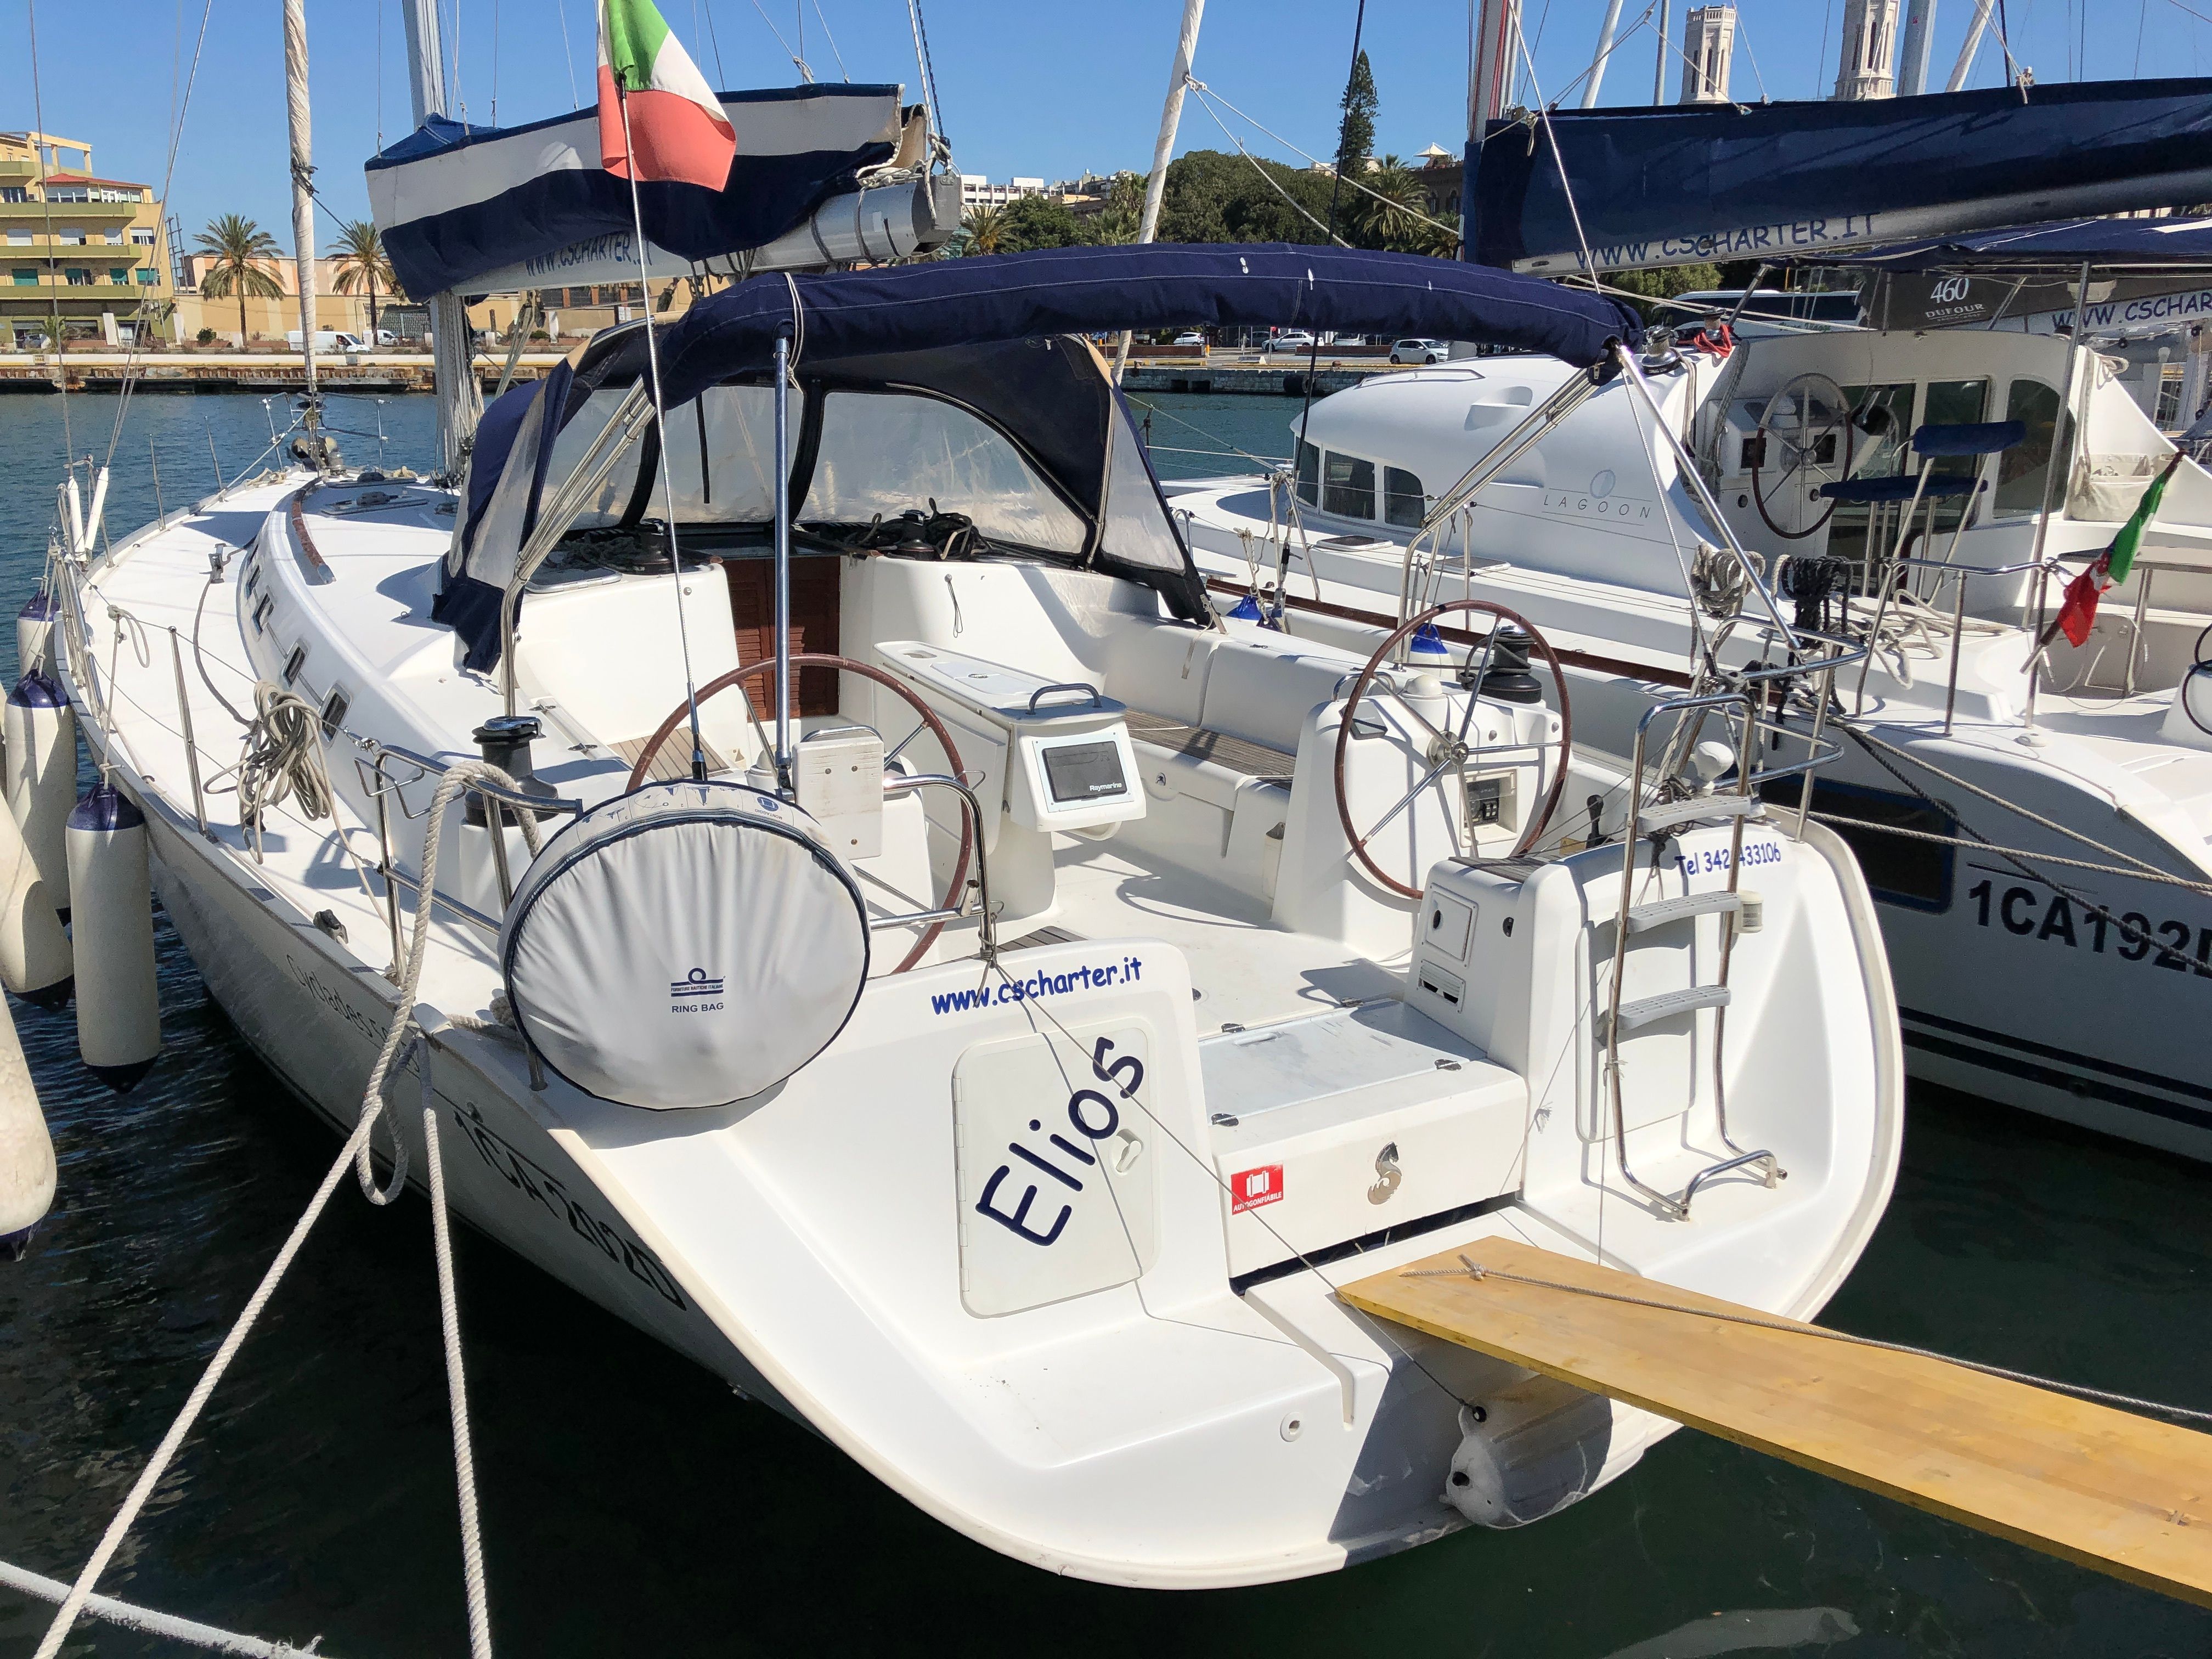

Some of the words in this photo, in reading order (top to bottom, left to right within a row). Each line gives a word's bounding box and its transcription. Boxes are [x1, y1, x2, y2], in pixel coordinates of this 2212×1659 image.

[1930, 278, 1970, 303] 460
[1925, 303, 1985, 318] DUFOUR
[1543, 494, 1651, 518] LAGOON
[1089, 782, 1122, 792] Raymarine
[1674, 852, 1700, 876] Tel
[1703, 842, 1781, 873] 342433106
[931, 956, 1142, 1015] www.cscharter.it
[672, 1005, 698, 1013] RING
[701, 1002, 724, 1012] BAG
[974, 1036, 1144, 1246] Elios
